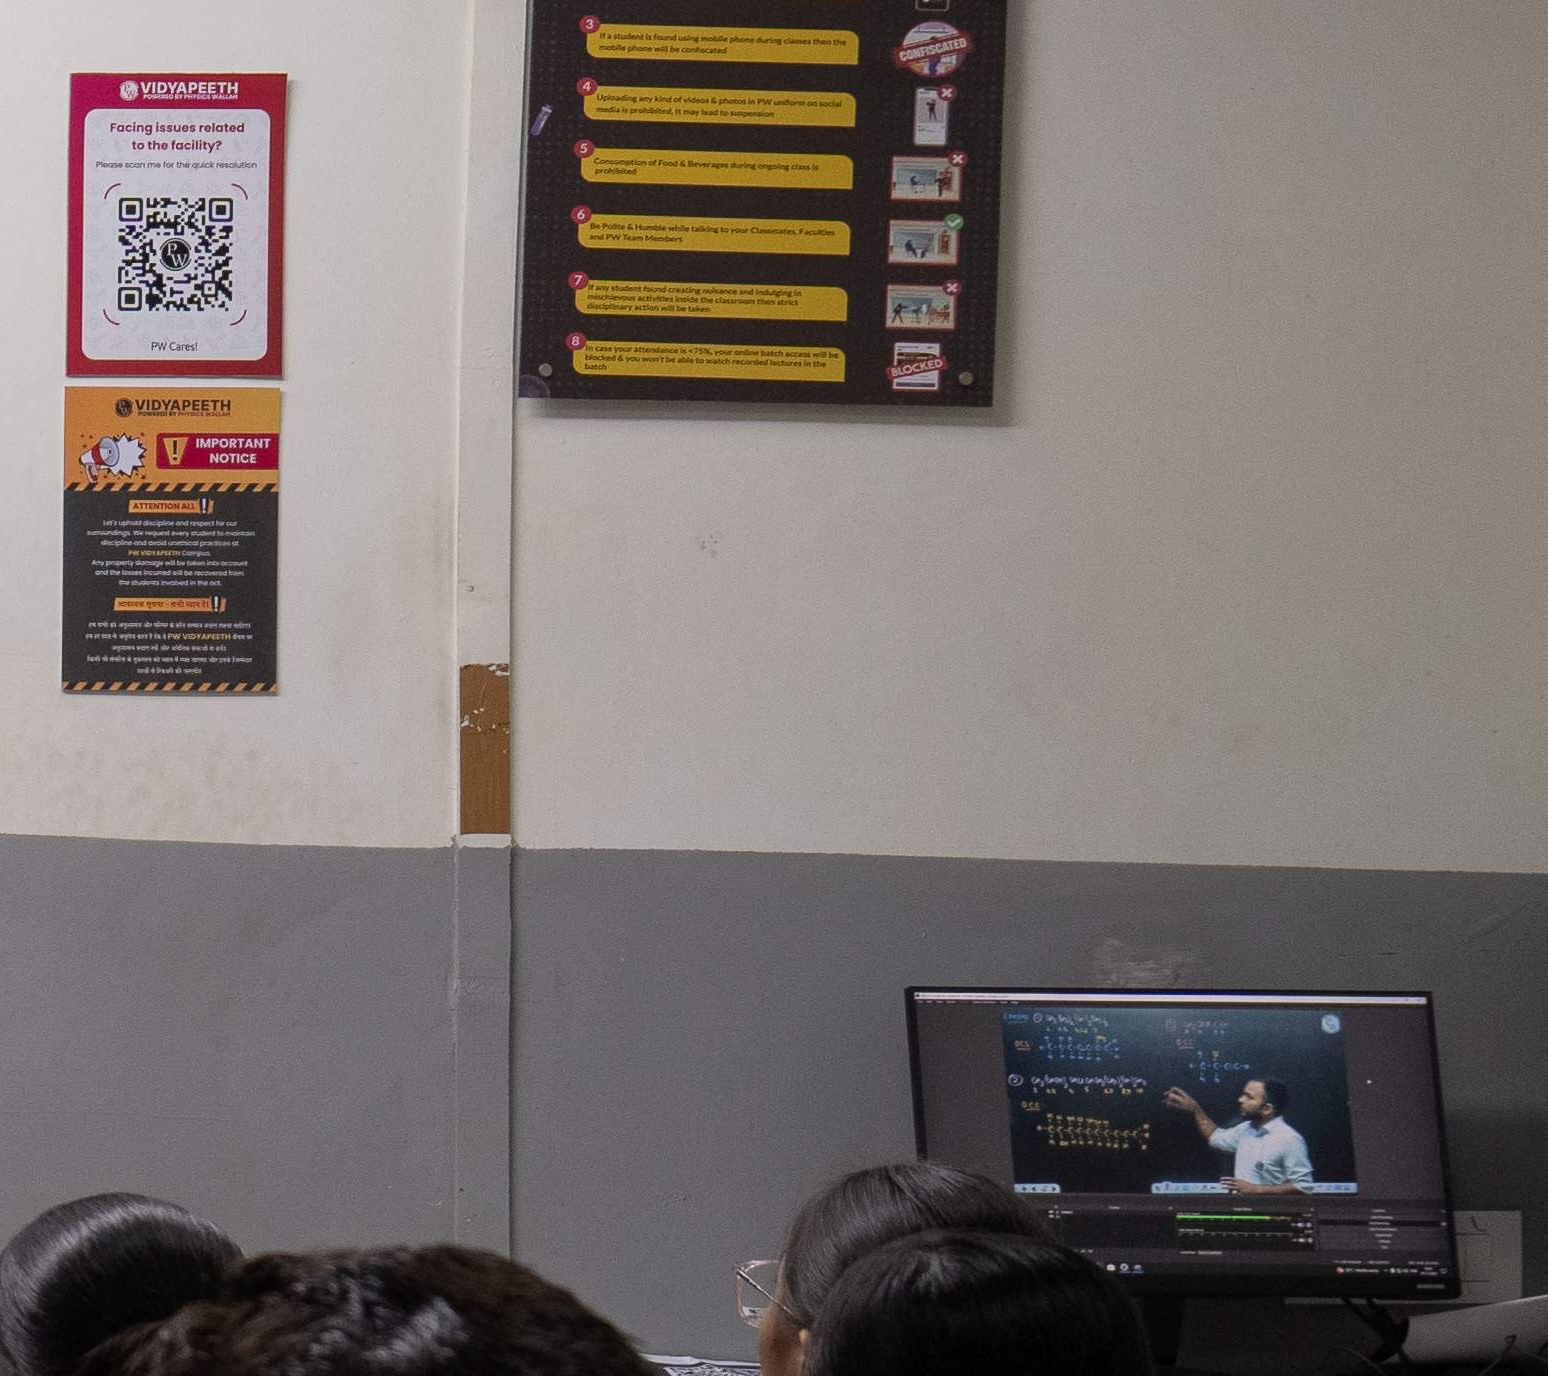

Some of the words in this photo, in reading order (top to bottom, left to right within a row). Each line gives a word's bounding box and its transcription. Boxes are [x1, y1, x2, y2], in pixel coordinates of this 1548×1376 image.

[585, 18, 595, 30] 3
[898, 36, 968, 64] CONFISCATED
[140, 81, 238, 96] VIDYAPEETH
[582, 81, 592, 93] 4
[109, 121, 153, 136] Facing
[155, 121, 196, 133] issues
[198, 122, 245, 133] related
[131, 140, 145, 150] to
[147, 140, 168, 150] the
[171, 139, 222, 154] facility?
[580, 143, 589, 154] 5
[95, 160, 123, 168] Please
[162, 161, 174, 169] for
[191, 161, 214, 170] quick
[215, 161, 258, 169] resolution
[577, 209, 586, 221] 6
[574, 275, 583, 286] 7
[150, 341, 167, 351] PW
[168, 341, 198, 351] Cares!
[571, 336, 581, 347] 8
[890, 357, 944, 379] BLOCKED
[134, 399, 231, 411] VIDYAPEETH
[195, 437, 271, 448] IMPORTANT
[209, 452, 256, 464] NOTICE
[132, 502, 180, 510] ATTENTION
[180, 502, 197, 510] ALL
